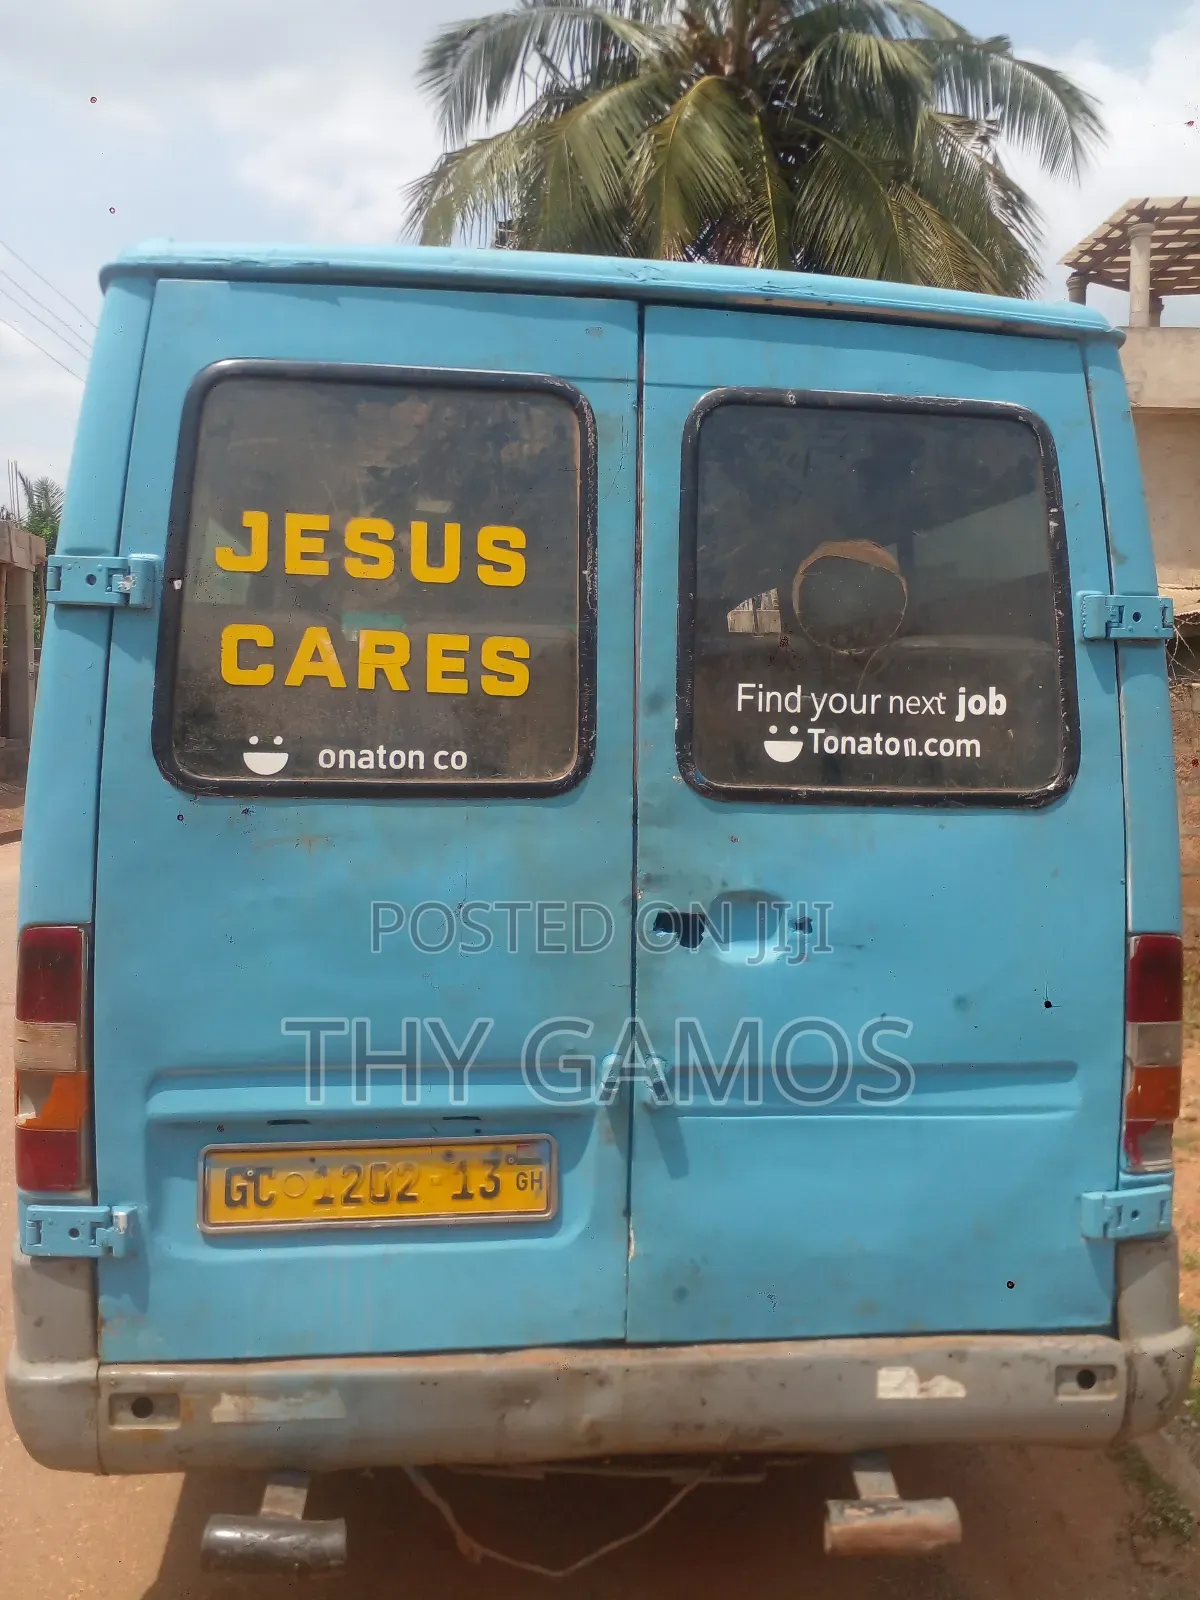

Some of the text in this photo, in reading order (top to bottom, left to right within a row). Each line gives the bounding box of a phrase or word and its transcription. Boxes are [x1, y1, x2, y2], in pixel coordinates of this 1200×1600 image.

[215, 510, 527, 587] JESUS
[220, 623, 531, 697] CARES
[736, 683, 1007, 722] Find your next job
[317, 745, 468, 771] onaton co
[807, 728, 981, 759] Tonaton.com
[515, 1170, 544, 1193] GH
